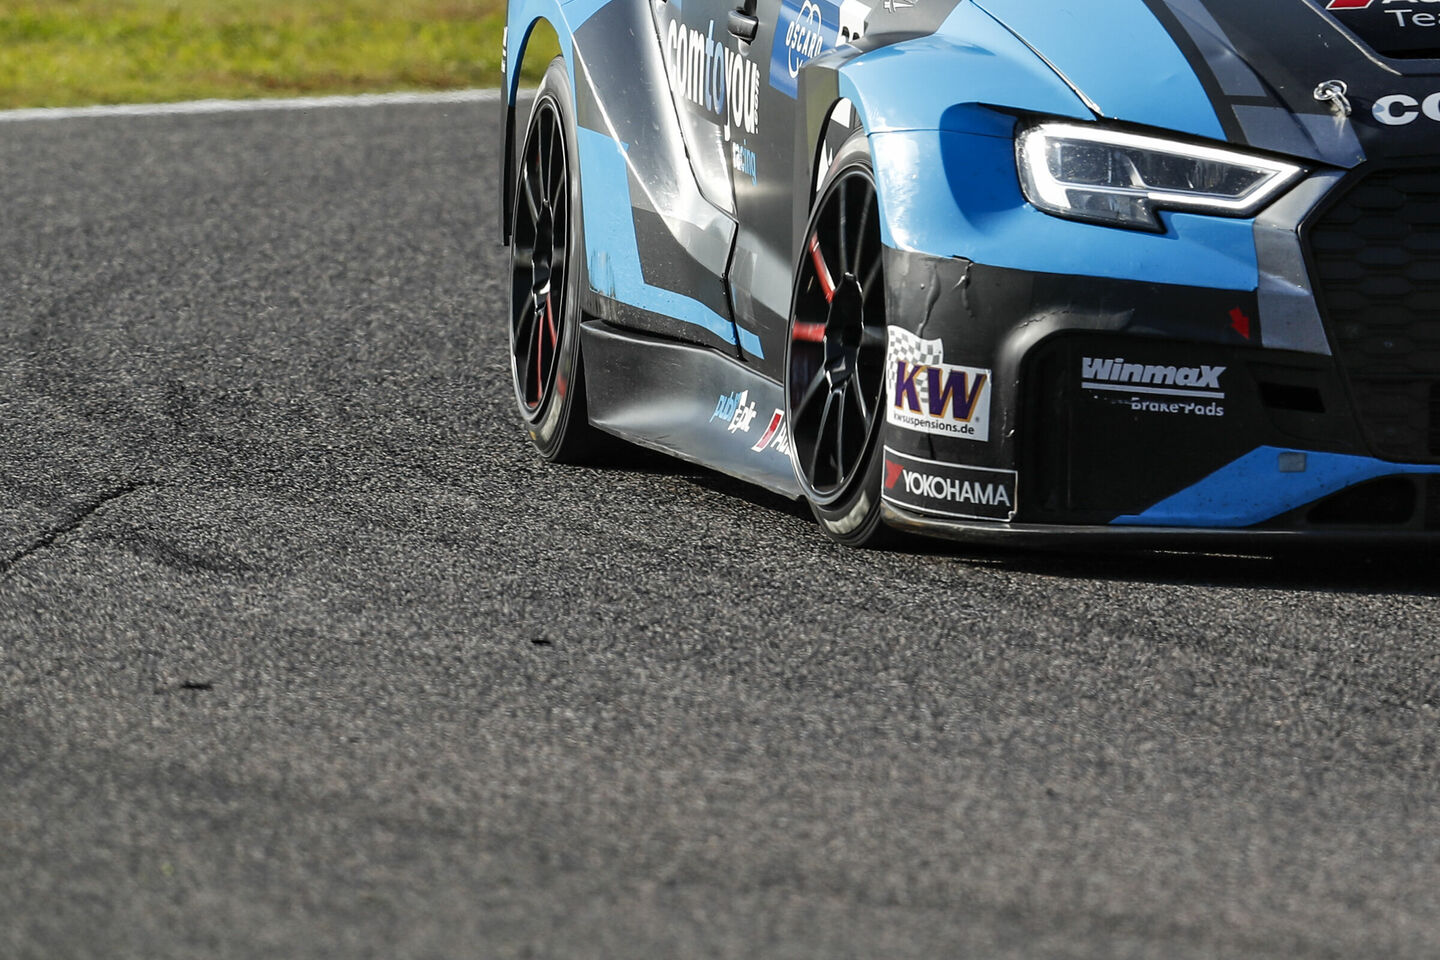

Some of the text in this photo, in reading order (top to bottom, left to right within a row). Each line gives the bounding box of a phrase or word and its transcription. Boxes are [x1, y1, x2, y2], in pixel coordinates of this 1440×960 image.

[667, 18, 757, 142] comtoyou
[732, 139, 758, 187] racing
[894, 360, 990, 422] KW
[893, 412, 976, 436] kwsuspensions.de
[902, 469, 1011, 507] YOKOHAMA
